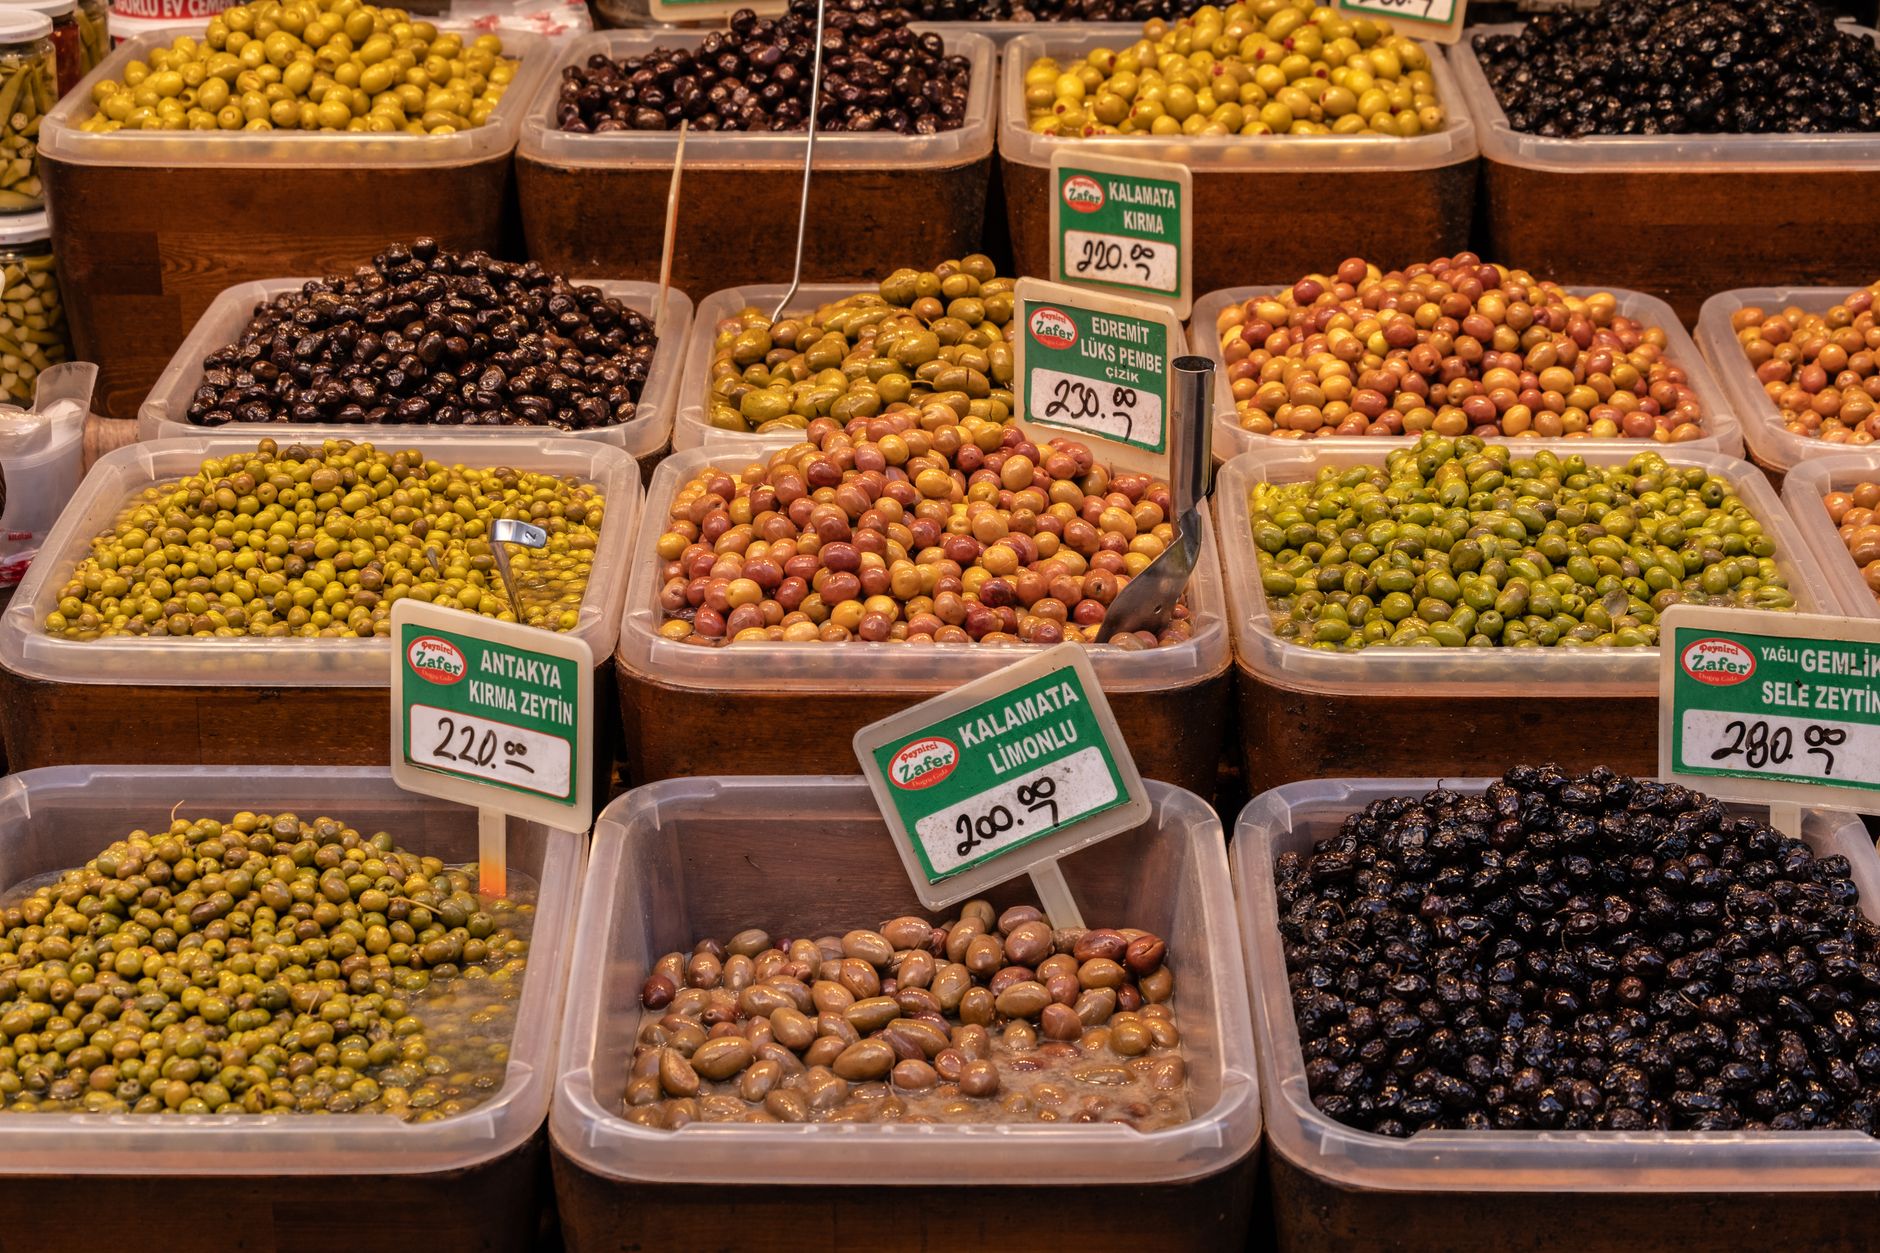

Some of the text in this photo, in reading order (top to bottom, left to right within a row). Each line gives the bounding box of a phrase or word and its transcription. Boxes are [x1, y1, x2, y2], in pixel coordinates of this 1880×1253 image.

[1069, 187, 1101, 204] Zafer
[1109, 182, 1176, 209] KALAMATA
[1123, 210, 1164, 234] KIRMA
[1036, 320, 1072, 340] Zafer
[1092, 316, 1149, 345] EDREMİT
[1080, 337, 1162, 374] LÜKS PEMBE
[1106, 365, 1140, 384] ÇİZİK
[421, 641, 453, 656] Peynirci
[1699, 644, 1739, 655] Peynirci
[1761, 646, 1880, 678] YAĞLI GEMLİK
[416, 651, 461, 675] Zafer
[480, 649, 562, 690] ANTAKYA
[1692, 655, 1748, 674] Zafer
[468, 679, 573, 727] KIRMA ZEYTİN
[1762, 681, 1880, 714] SELE ZEYTİN
[957, 681, 1080, 749] KALAMATA
[900, 741, 939, 763] Peynirci
[988, 719, 1078, 775] LİMONLU
[899, 753, 953, 783] Zafer
